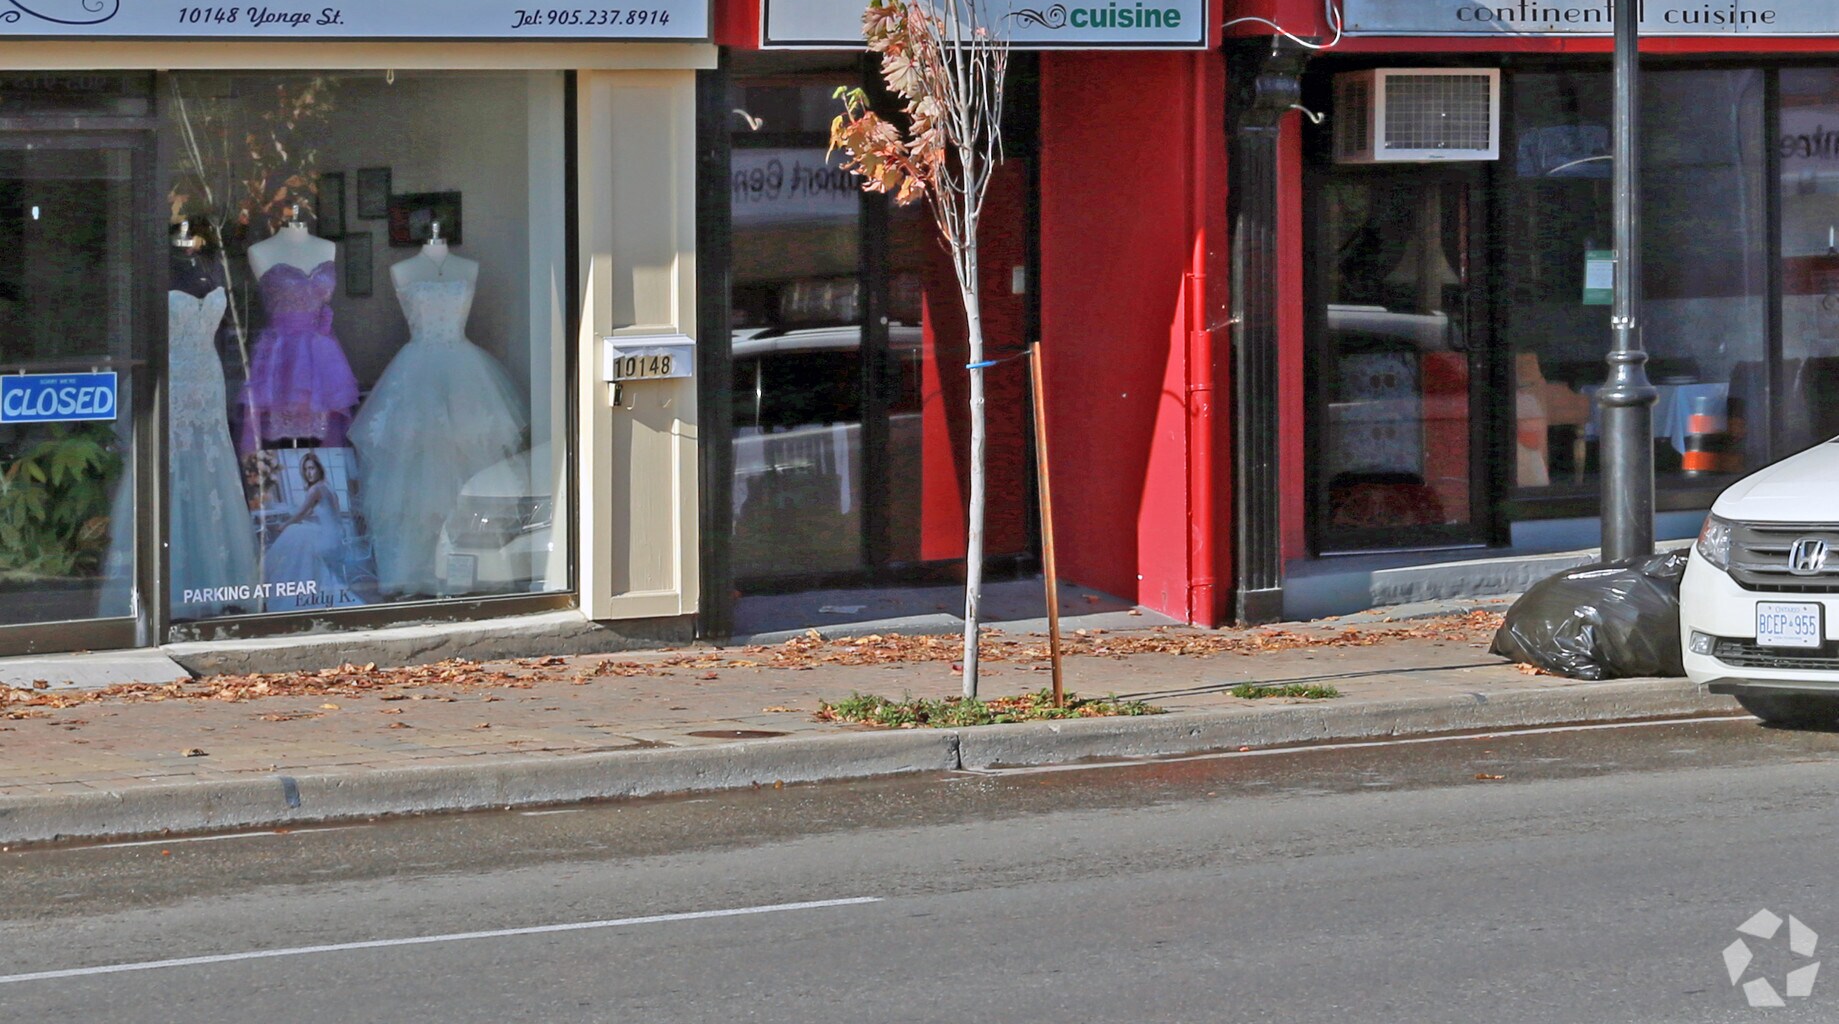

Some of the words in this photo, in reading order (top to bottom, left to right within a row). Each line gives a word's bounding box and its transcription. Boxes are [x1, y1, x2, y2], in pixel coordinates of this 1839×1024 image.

[178, 6, 240, 24] 10148
[246, 6, 312, 28] Yonge
[315, 7, 344, 26] St.
[547, 9, 671, 28] 905.237.8914
[1070, 2, 1182, 29] cuisine
[1664, 3, 1777, 25] cuisine
[614, 355, 671, 378] 10148
[3, 386, 114, 416] CLOSED
[183, 585, 251, 604] PARKING
[253, 583, 272, 599] AT
[276, 580, 318, 597] REAR
